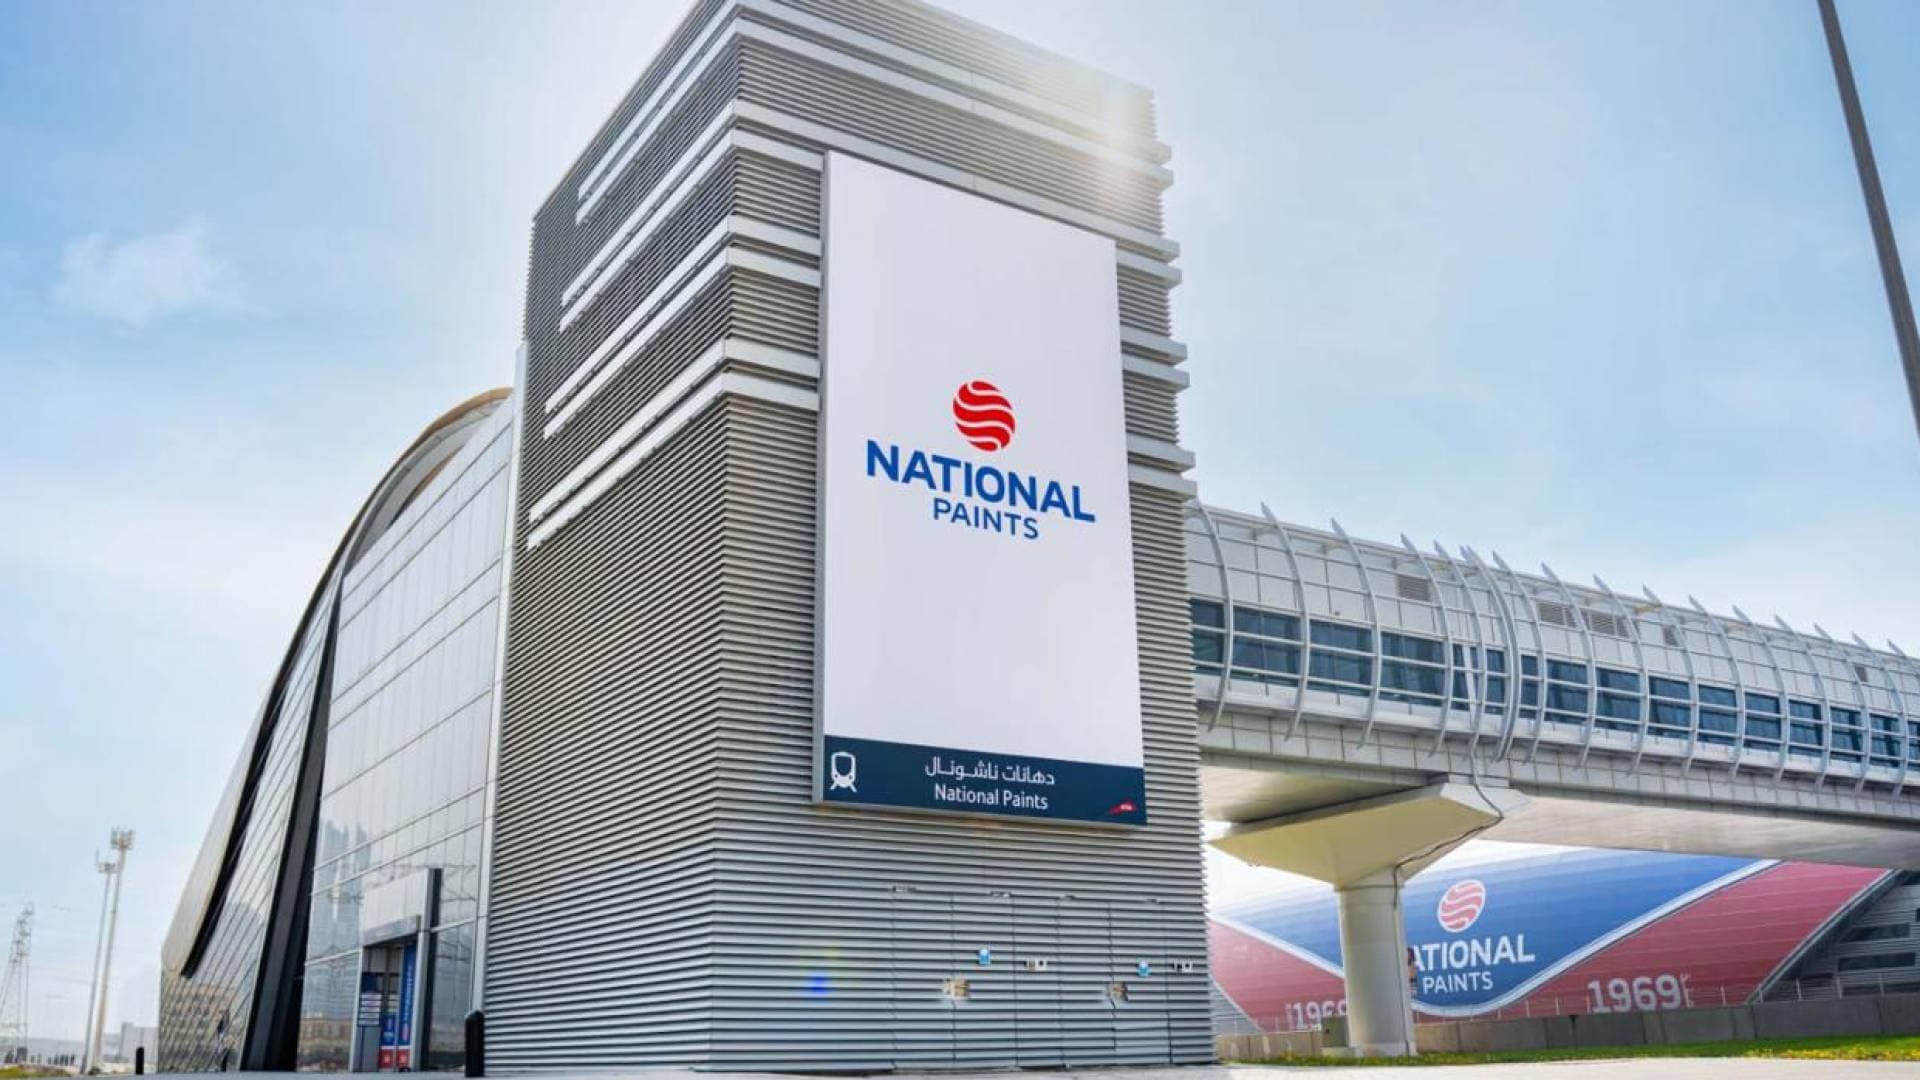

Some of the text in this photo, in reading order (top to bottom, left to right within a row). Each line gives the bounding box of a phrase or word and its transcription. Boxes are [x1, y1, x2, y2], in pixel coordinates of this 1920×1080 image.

[866, 439, 1096, 523] NATIONAL
[933, 497, 1039, 540] PAINTS
[925, 755, 1055, 785] دهانات ناشونال
[935, 782, 1049, 811] National Paints
[1413, 933, 1536, 971] ATIONAL
[1422, 971, 1494, 995] PAINTS
[1587, 974, 1681, 1013] 1969
